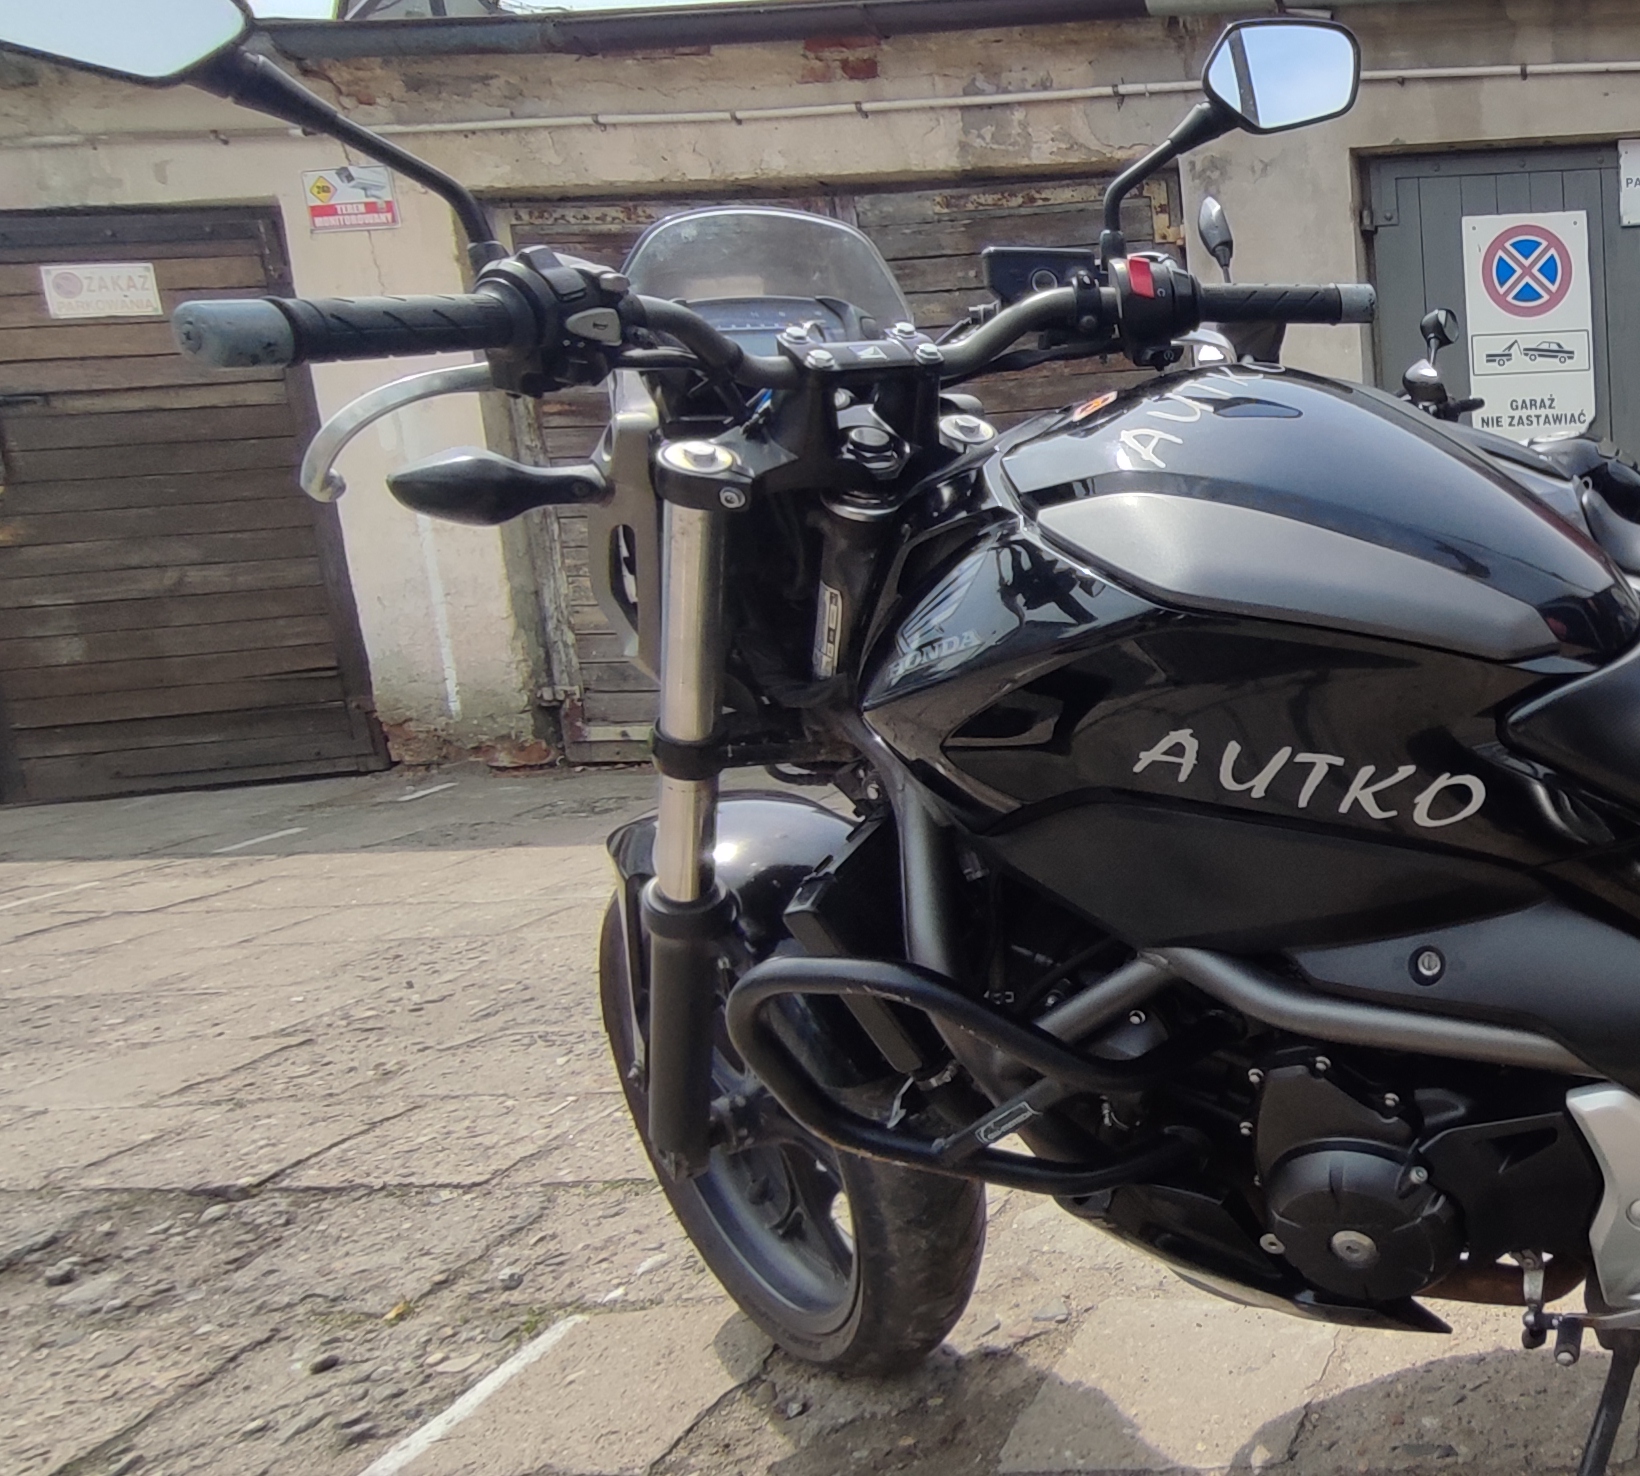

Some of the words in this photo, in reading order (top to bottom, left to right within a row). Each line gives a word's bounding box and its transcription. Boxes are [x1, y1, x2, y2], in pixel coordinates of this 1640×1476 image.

[83, 275, 153, 293] ZAKAZ
[57, 299, 156, 312] PARKOWANIA
[1510, 394, 1556, 411] GARAŻ
[1481, 416, 1504, 428] NIE
[1508, 409, 1587, 427] ZASTAWIAĆ
[887, 630, 981, 681] HONDA
[1132, 728, 1486, 828] AUTKO
